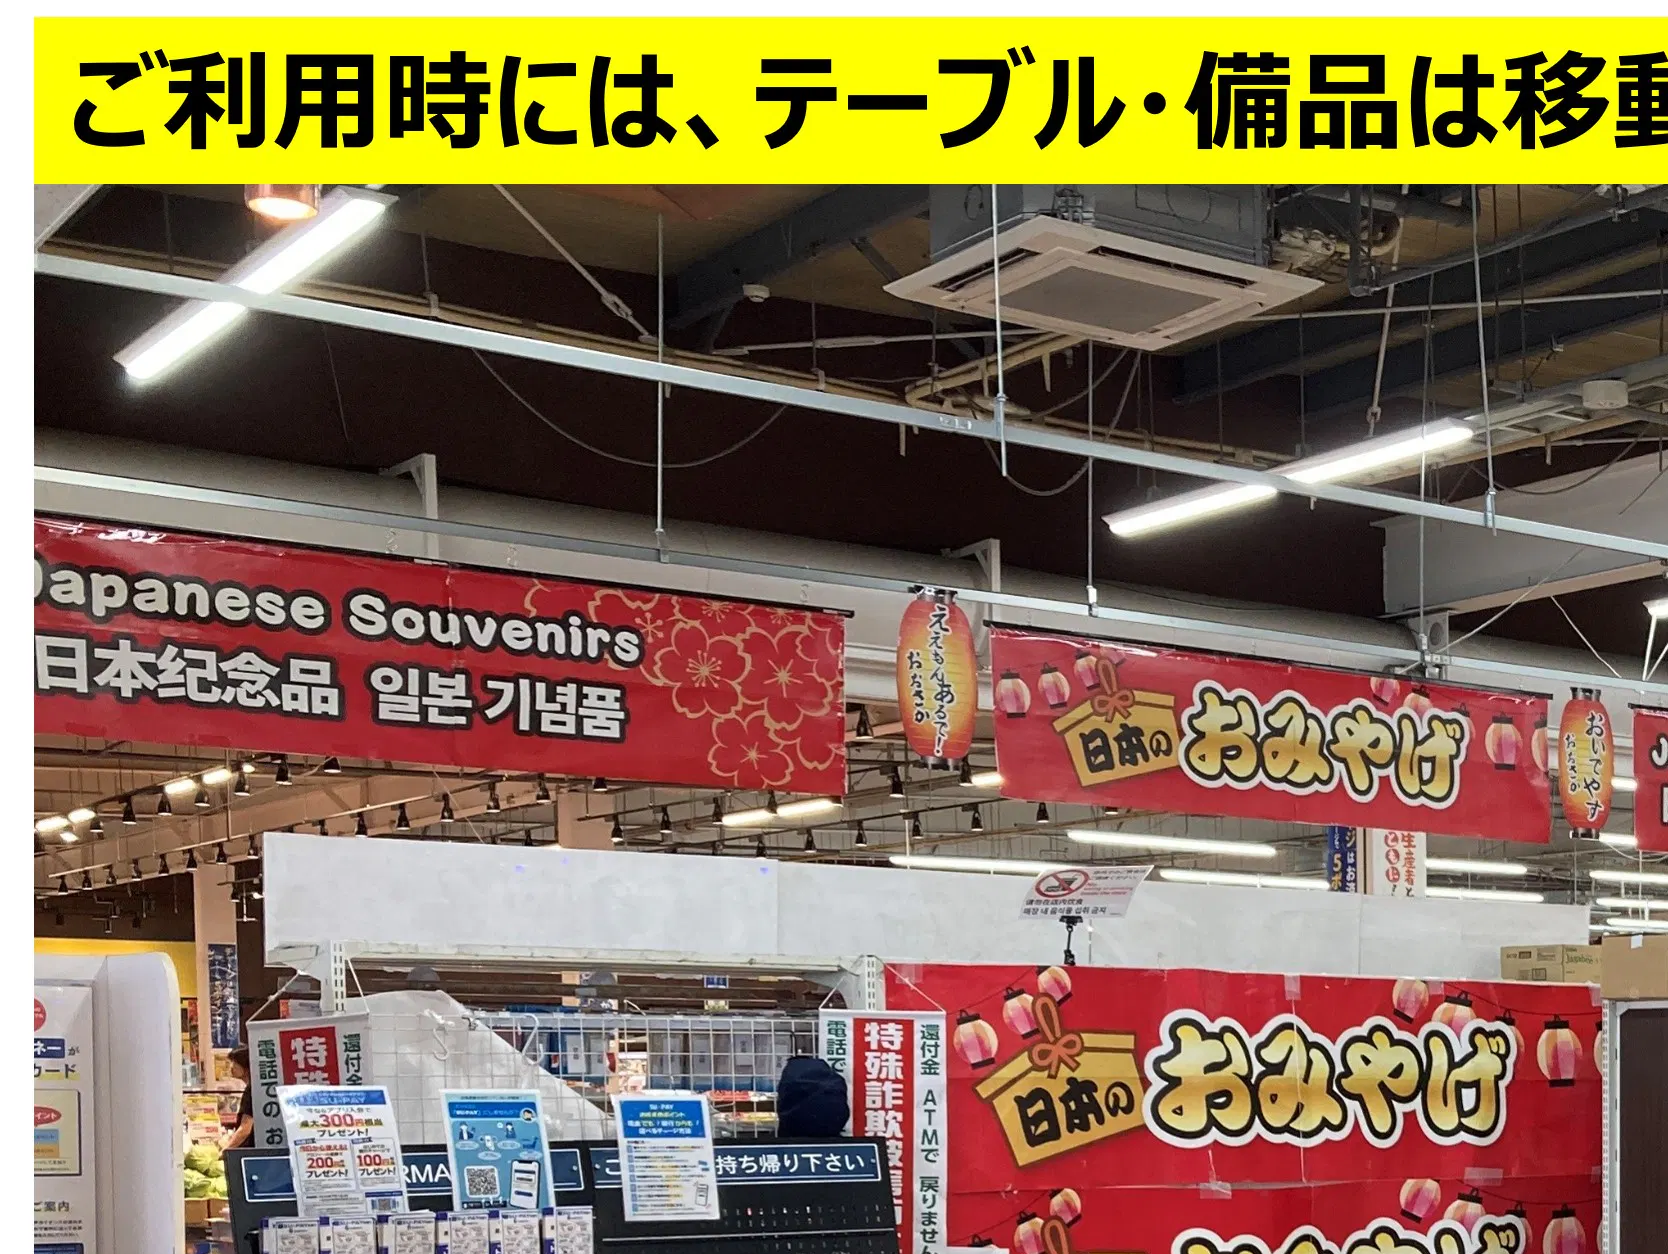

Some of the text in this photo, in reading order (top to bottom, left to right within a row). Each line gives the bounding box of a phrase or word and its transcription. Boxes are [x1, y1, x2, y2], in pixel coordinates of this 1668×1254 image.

[349, 594, 642, 662] Souvenirs
[35, 638, 339, 717] 日本纪念品
[370, 666, 626, 740] 일본 기념품
[1079, 728, 1172, 774] 日本の
[1184, 686, 1465, 802] おみやげ
[1584, 710, 1604, 821] おいでやす
[921, 1024, 940, 1075] 還付金
[1151, 1018, 1513, 1141] おみやげ
[922, 1089, 940, 1163] ATMで
[1014, 1080, 1136, 1147] 日本の
